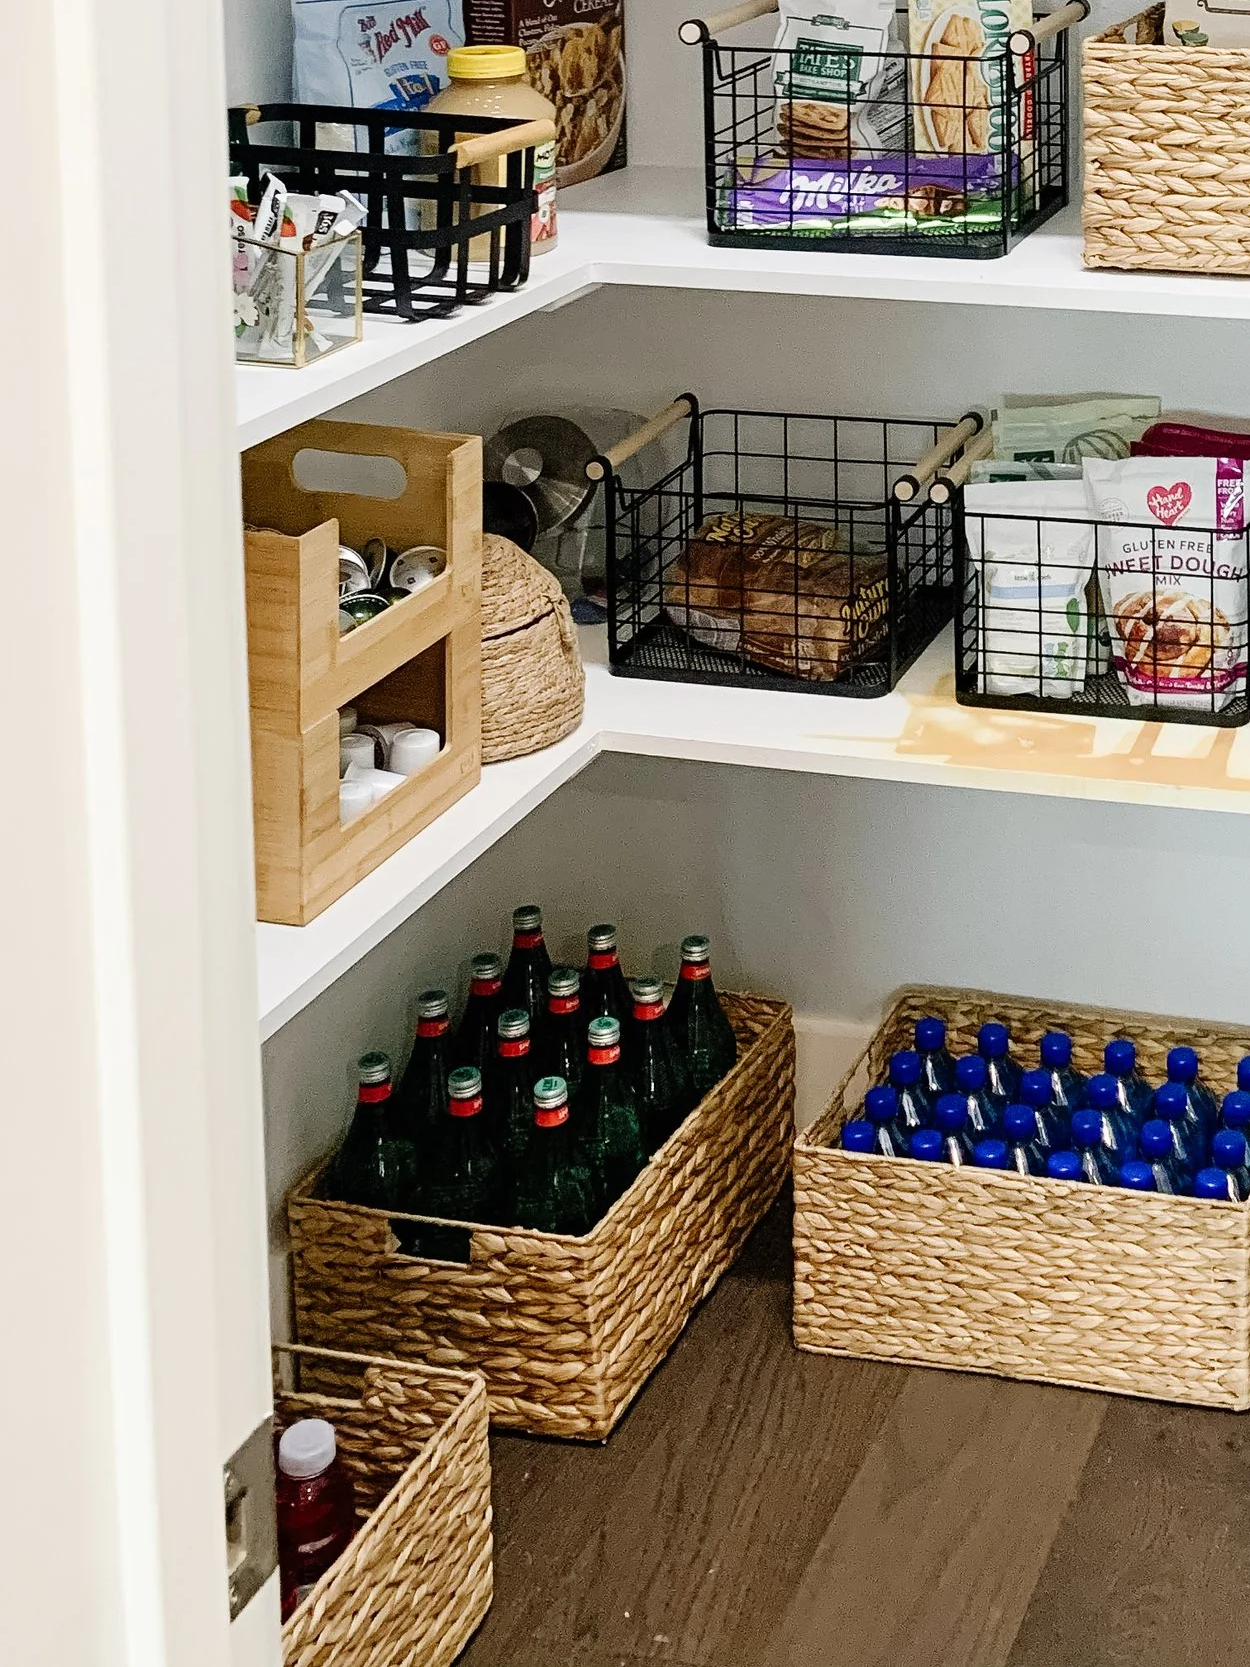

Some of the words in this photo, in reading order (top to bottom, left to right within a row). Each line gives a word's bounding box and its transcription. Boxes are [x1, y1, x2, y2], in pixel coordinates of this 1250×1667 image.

[373, 21, 401, 63] Red
[396, 5, 432, 48] Mill
[384, 62, 409, 77] GLUTEN
[409, 60, 429, 70] FREE
[800, 64, 819, 74] BAKE
[821, 67, 848, 78] SHOP
[778, 165, 903, 211] Milka
[1149, 486, 1184, 506] Hand
[1155, 499, 1185, 519] Heart
[1180, 540, 1212, 554] FREE
[1170, 555, 1243, 583] DOUGH
[1154, 575, 1182, 586] MIX
